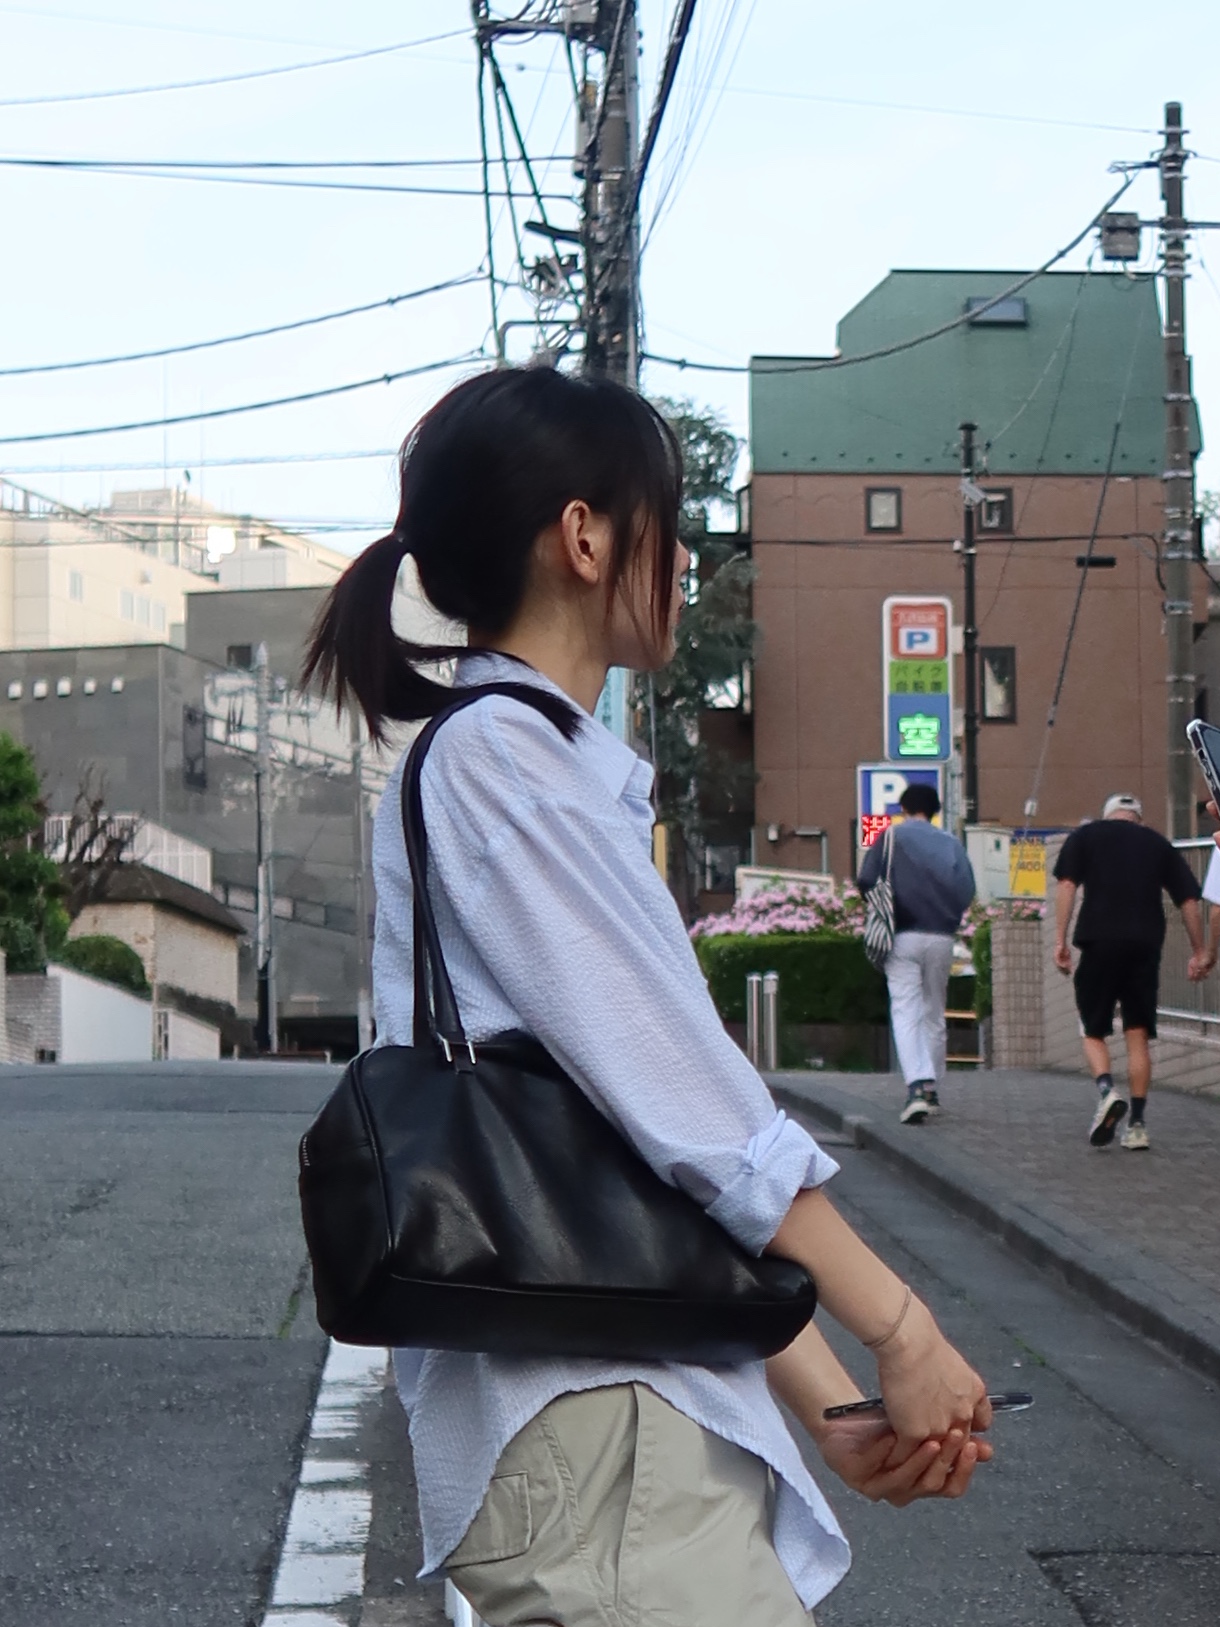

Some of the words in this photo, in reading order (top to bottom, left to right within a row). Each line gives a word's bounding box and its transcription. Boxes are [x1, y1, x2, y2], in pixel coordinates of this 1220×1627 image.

[906, 631, 930, 650] P
[898, 712, 940, 756] 空
[871, 771, 908, 815] P
